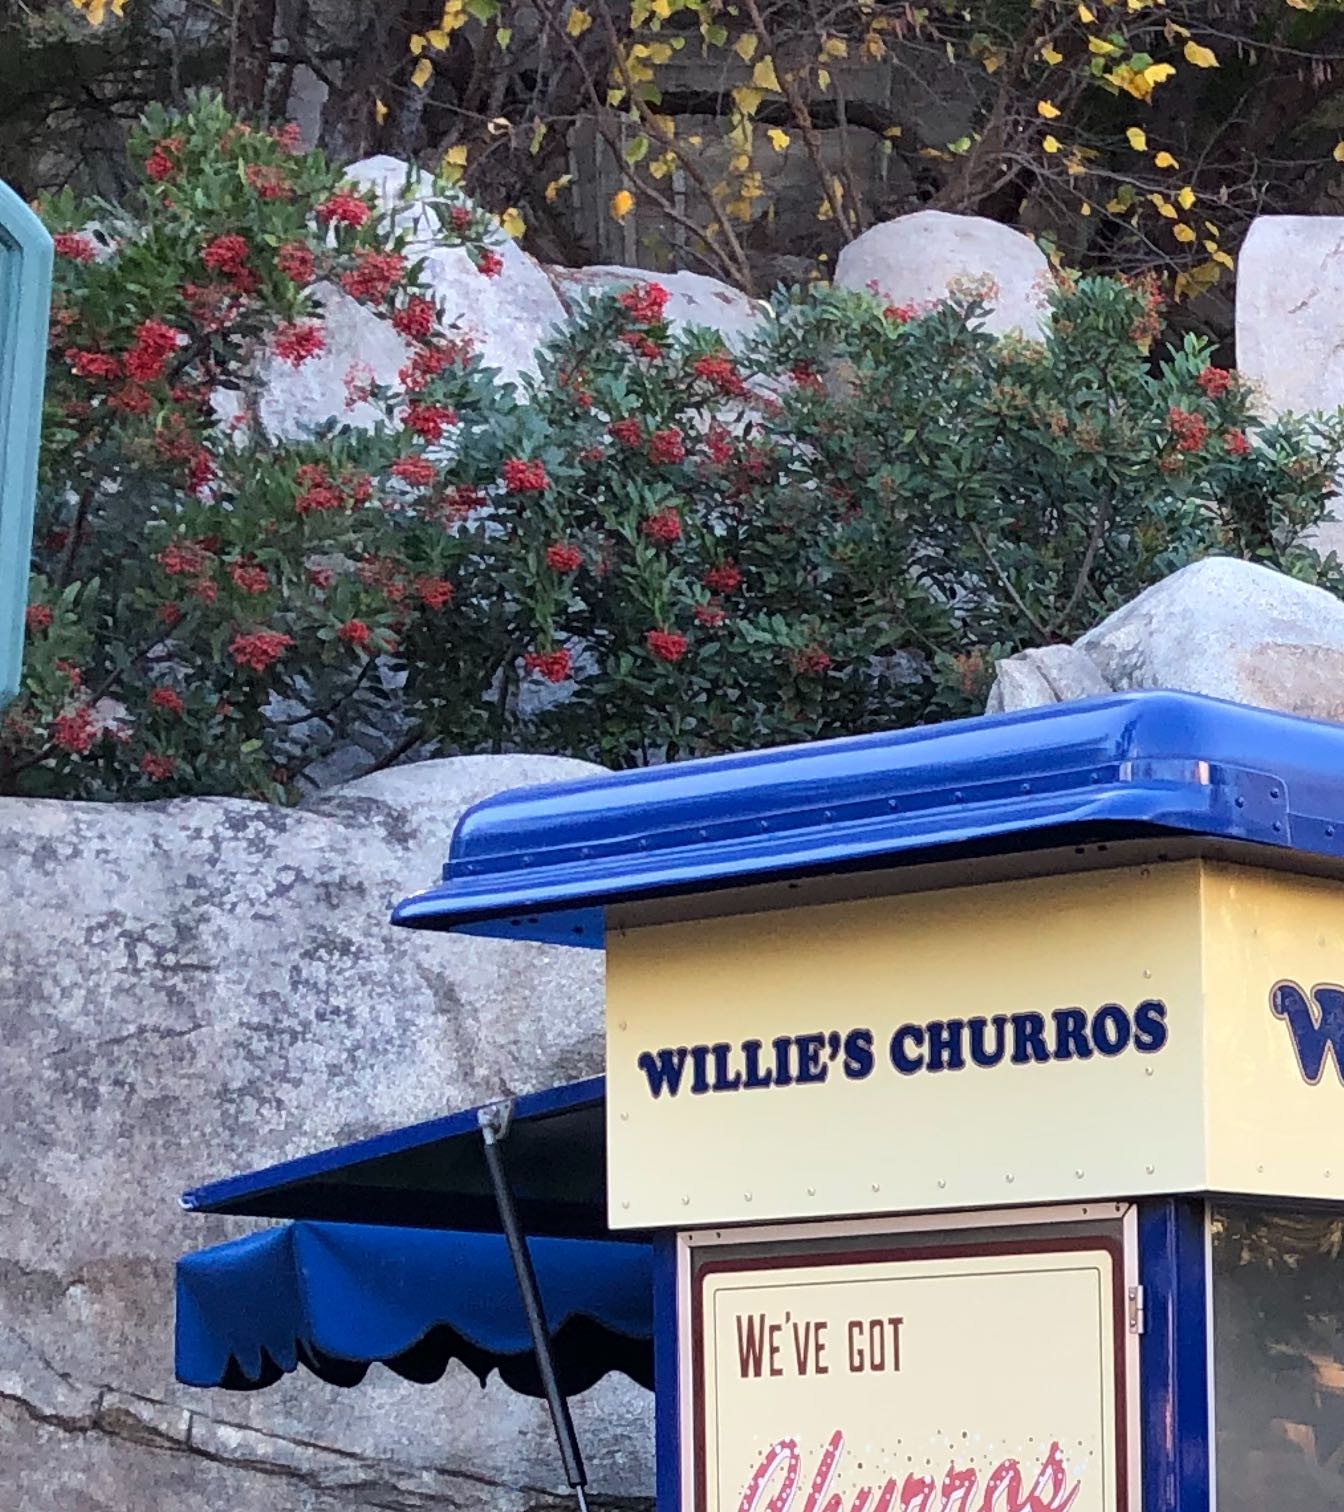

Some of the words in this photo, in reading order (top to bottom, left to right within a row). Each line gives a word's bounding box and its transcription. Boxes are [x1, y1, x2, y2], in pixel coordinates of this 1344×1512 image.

[637, 1029, 875, 1099] WILLIE'S
[889, 999, 1168, 1076] CHURROS
[736, 1312, 829, 1378] WE'VE
[848, 1316, 904, 1372] GOT
